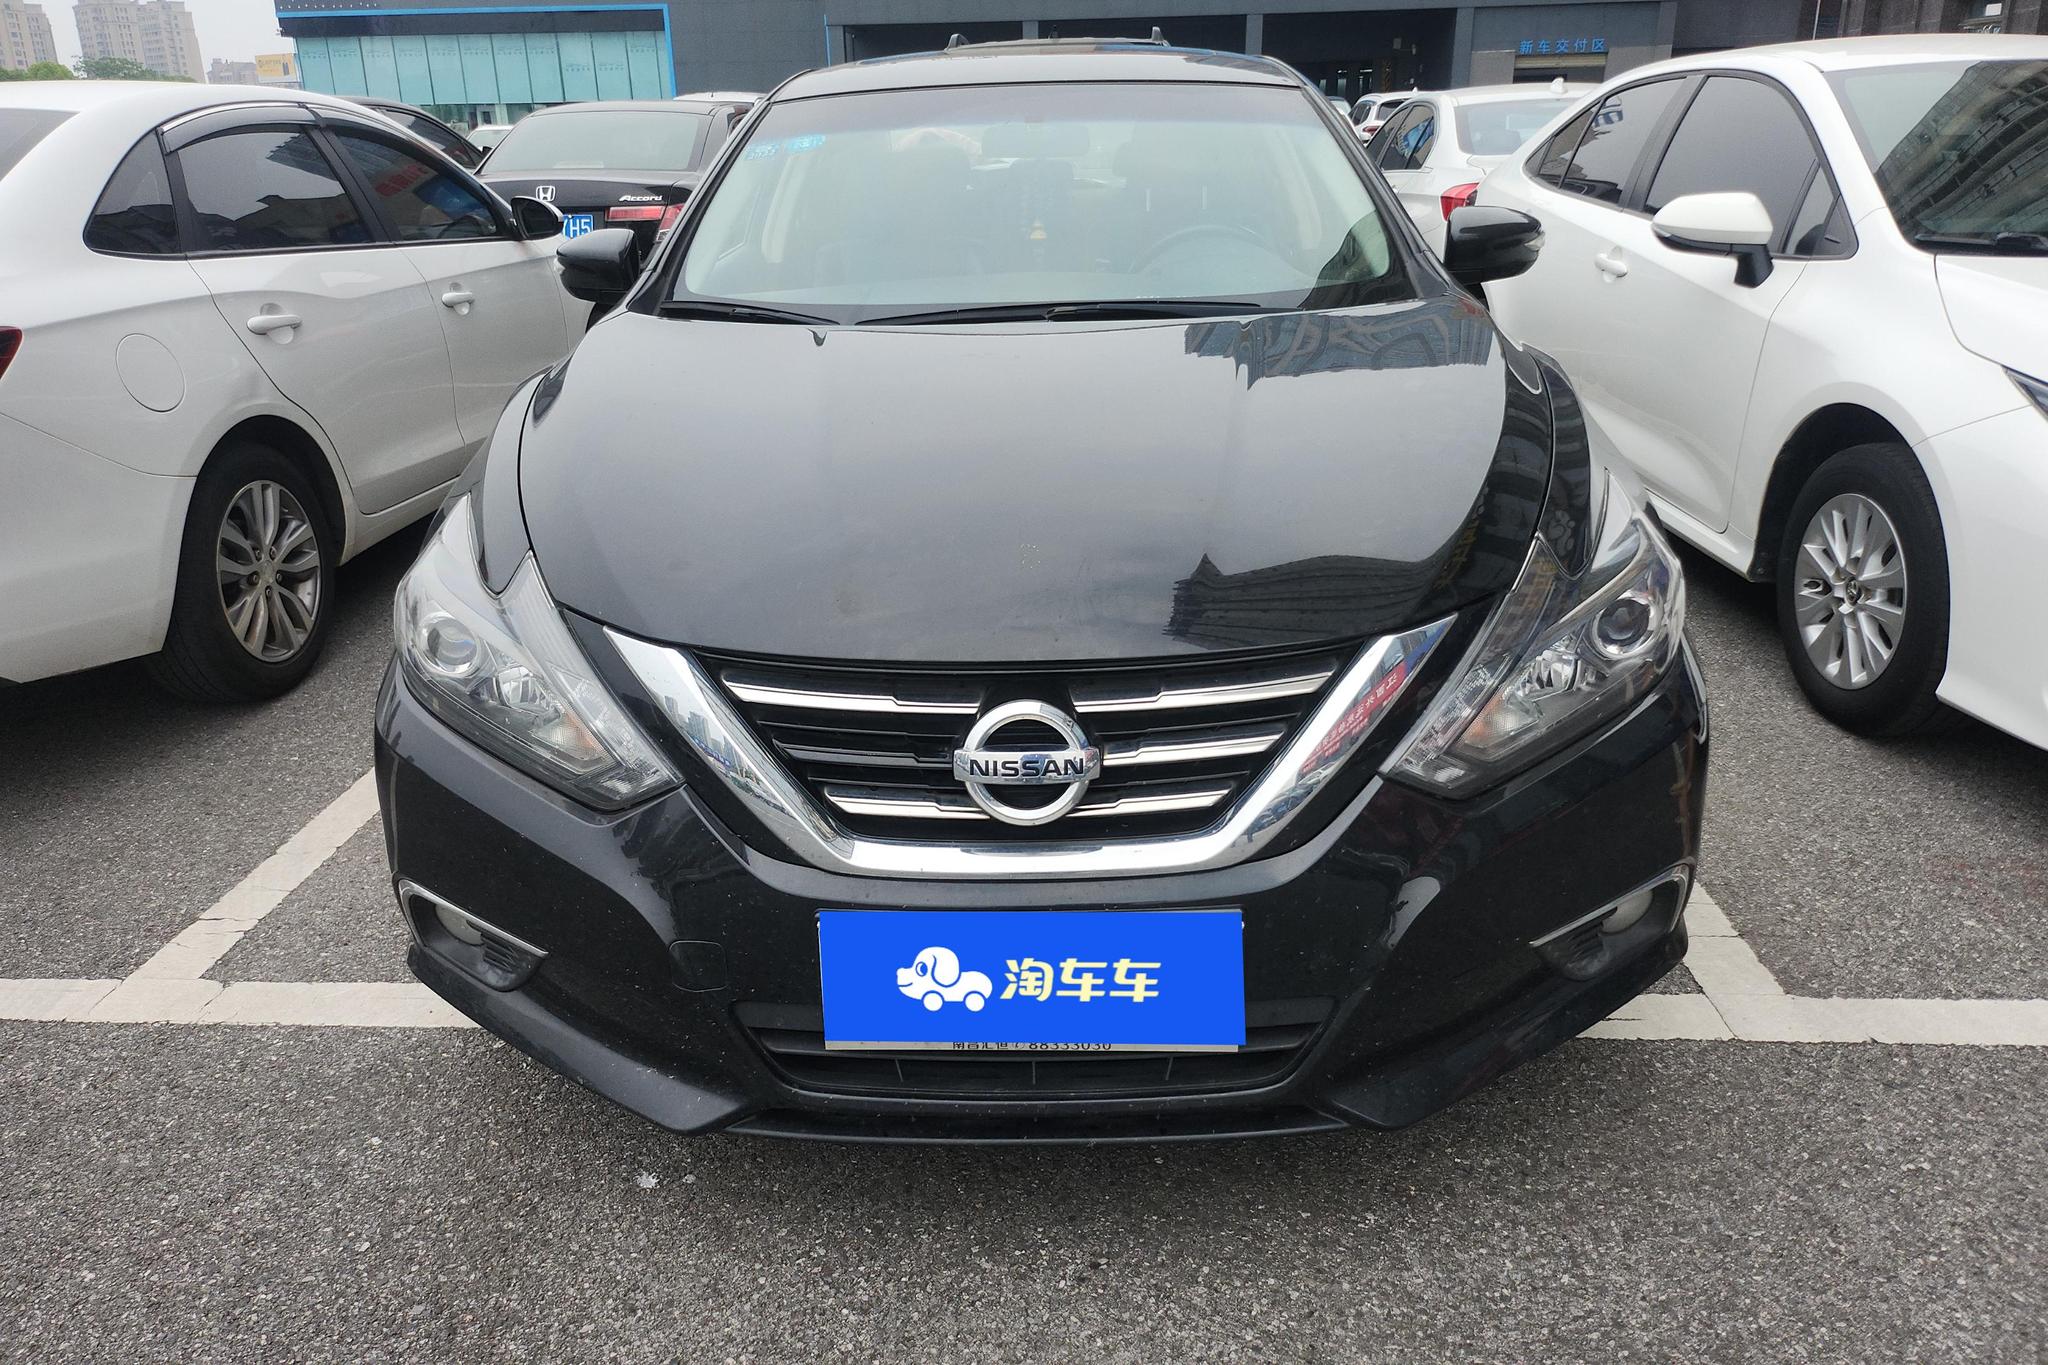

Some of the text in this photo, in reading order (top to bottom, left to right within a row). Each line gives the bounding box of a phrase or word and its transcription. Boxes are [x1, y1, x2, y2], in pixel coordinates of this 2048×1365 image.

[1519, 38, 1605, 54] 新车交付区
[619, 194, 663, 202] Accord
[969, 759, 1084, 777] NISSAN
